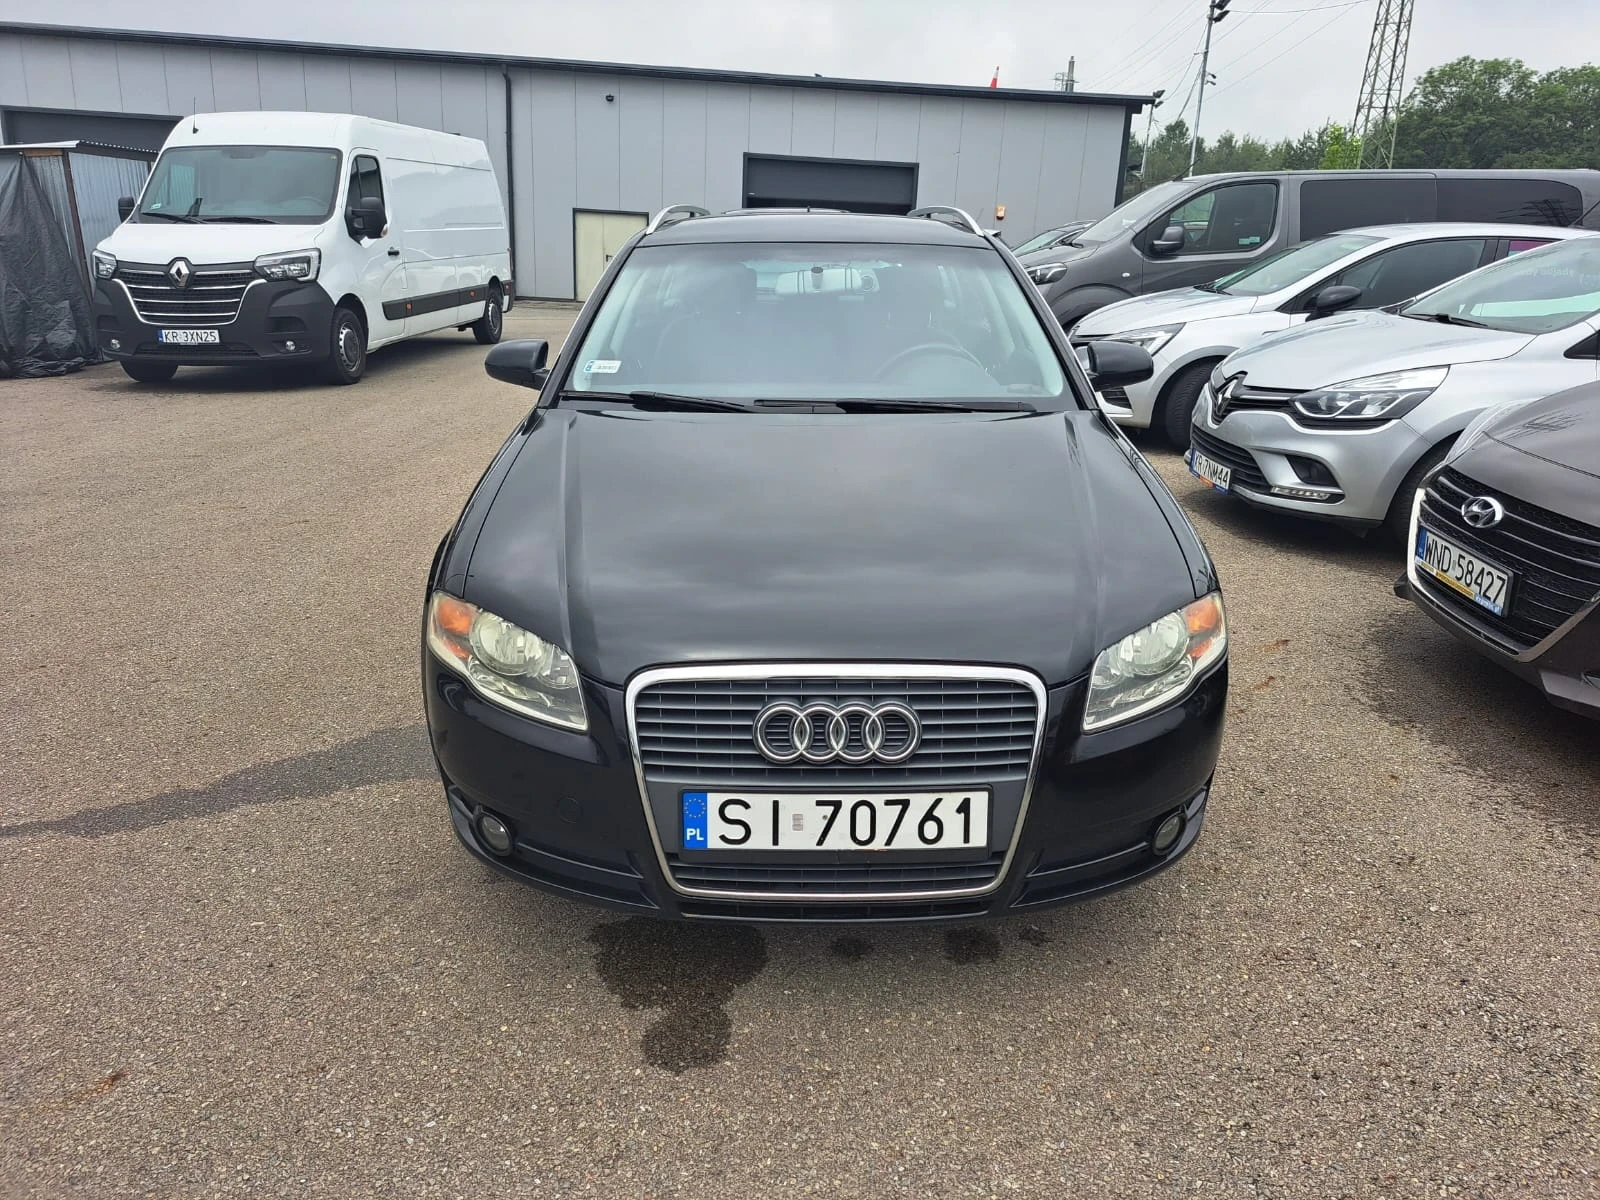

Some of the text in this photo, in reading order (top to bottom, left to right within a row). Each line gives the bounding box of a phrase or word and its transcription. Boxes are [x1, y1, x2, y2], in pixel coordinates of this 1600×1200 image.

[164, 331, 179, 342] KR
[182, 331, 217, 342] 3XN25
[1203, 458, 1230, 488] 7NM44
[1424, 537, 1452, 573] WND
[1455, 553, 1507, 603] 58427
[686, 828, 705, 841] PL
[718, 797, 972, 847] SI 70761
